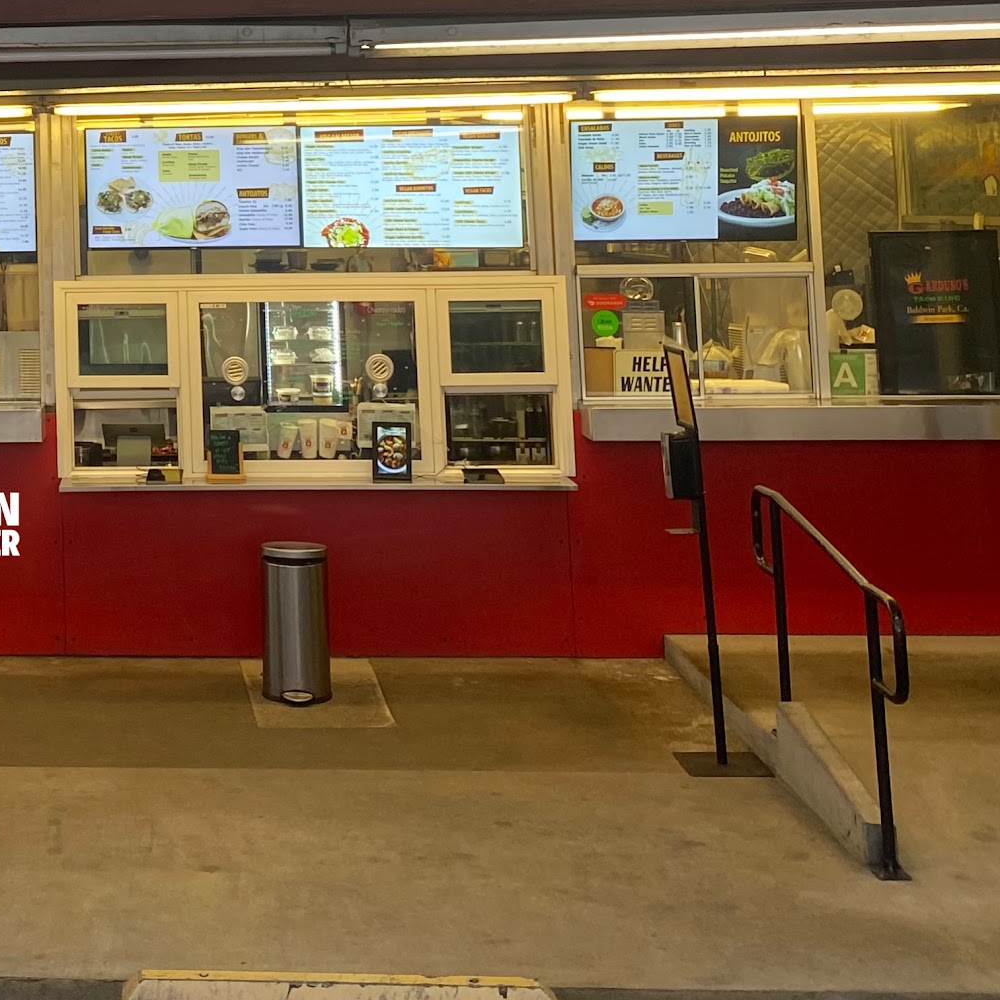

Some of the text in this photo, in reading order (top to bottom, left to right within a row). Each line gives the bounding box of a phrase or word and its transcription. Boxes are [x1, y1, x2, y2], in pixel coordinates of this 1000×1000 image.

[729, 131, 781, 143] ANTOJITOS
[907, 306, 936, 314] Baldwin
[833, 362, 859, 389] A
